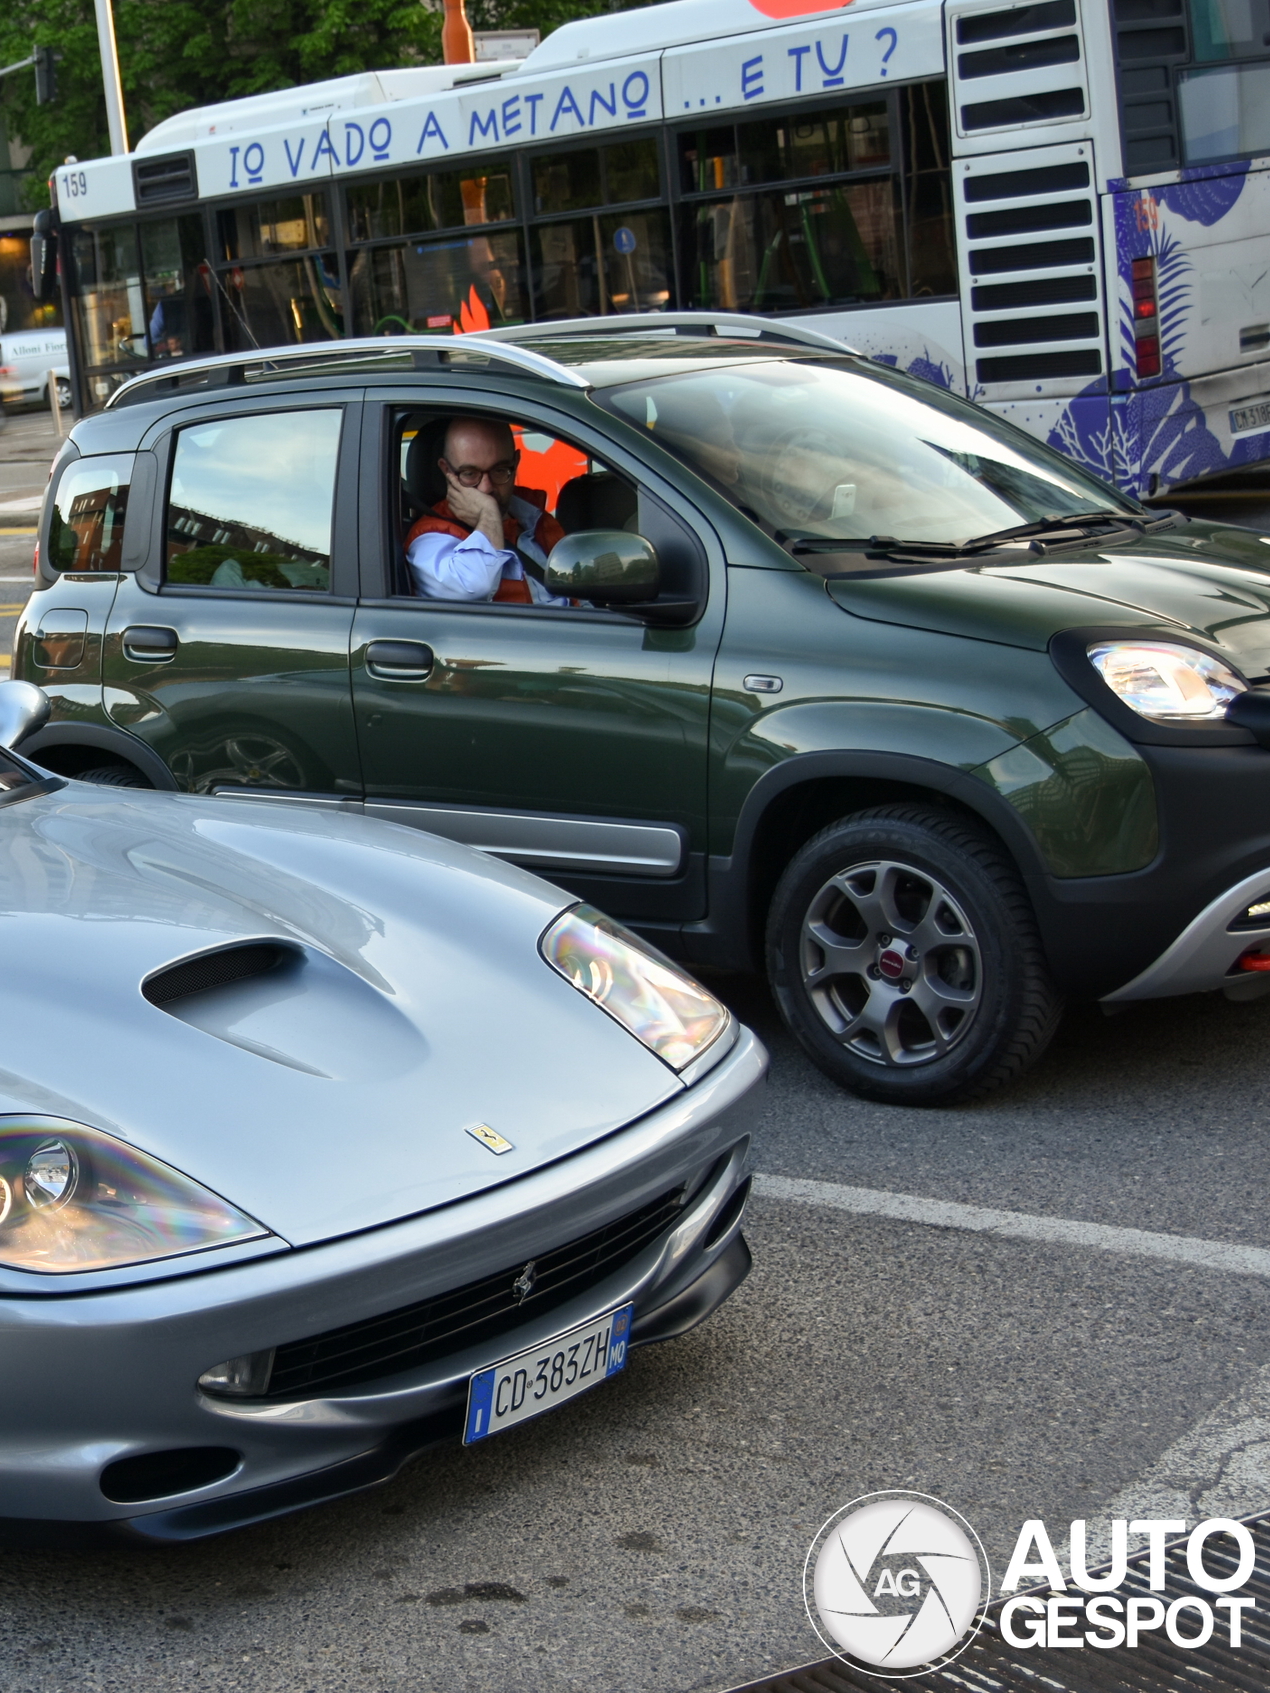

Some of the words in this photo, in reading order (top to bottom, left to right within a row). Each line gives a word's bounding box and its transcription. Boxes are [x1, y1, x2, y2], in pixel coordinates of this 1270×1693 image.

[230, 143, 265, 188] IO
[284, 117, 392, 177] VADO
[417, 111, 449, 154] A
[468, 71, 649, 146] METANO
[741, 54, 764, 100] E
[787, 34, 849, 92] TU
[63, 172, 87, 198] 159
[1133, 197, 1159, 232] 159
[609, 1340, 626, 1369] MO
